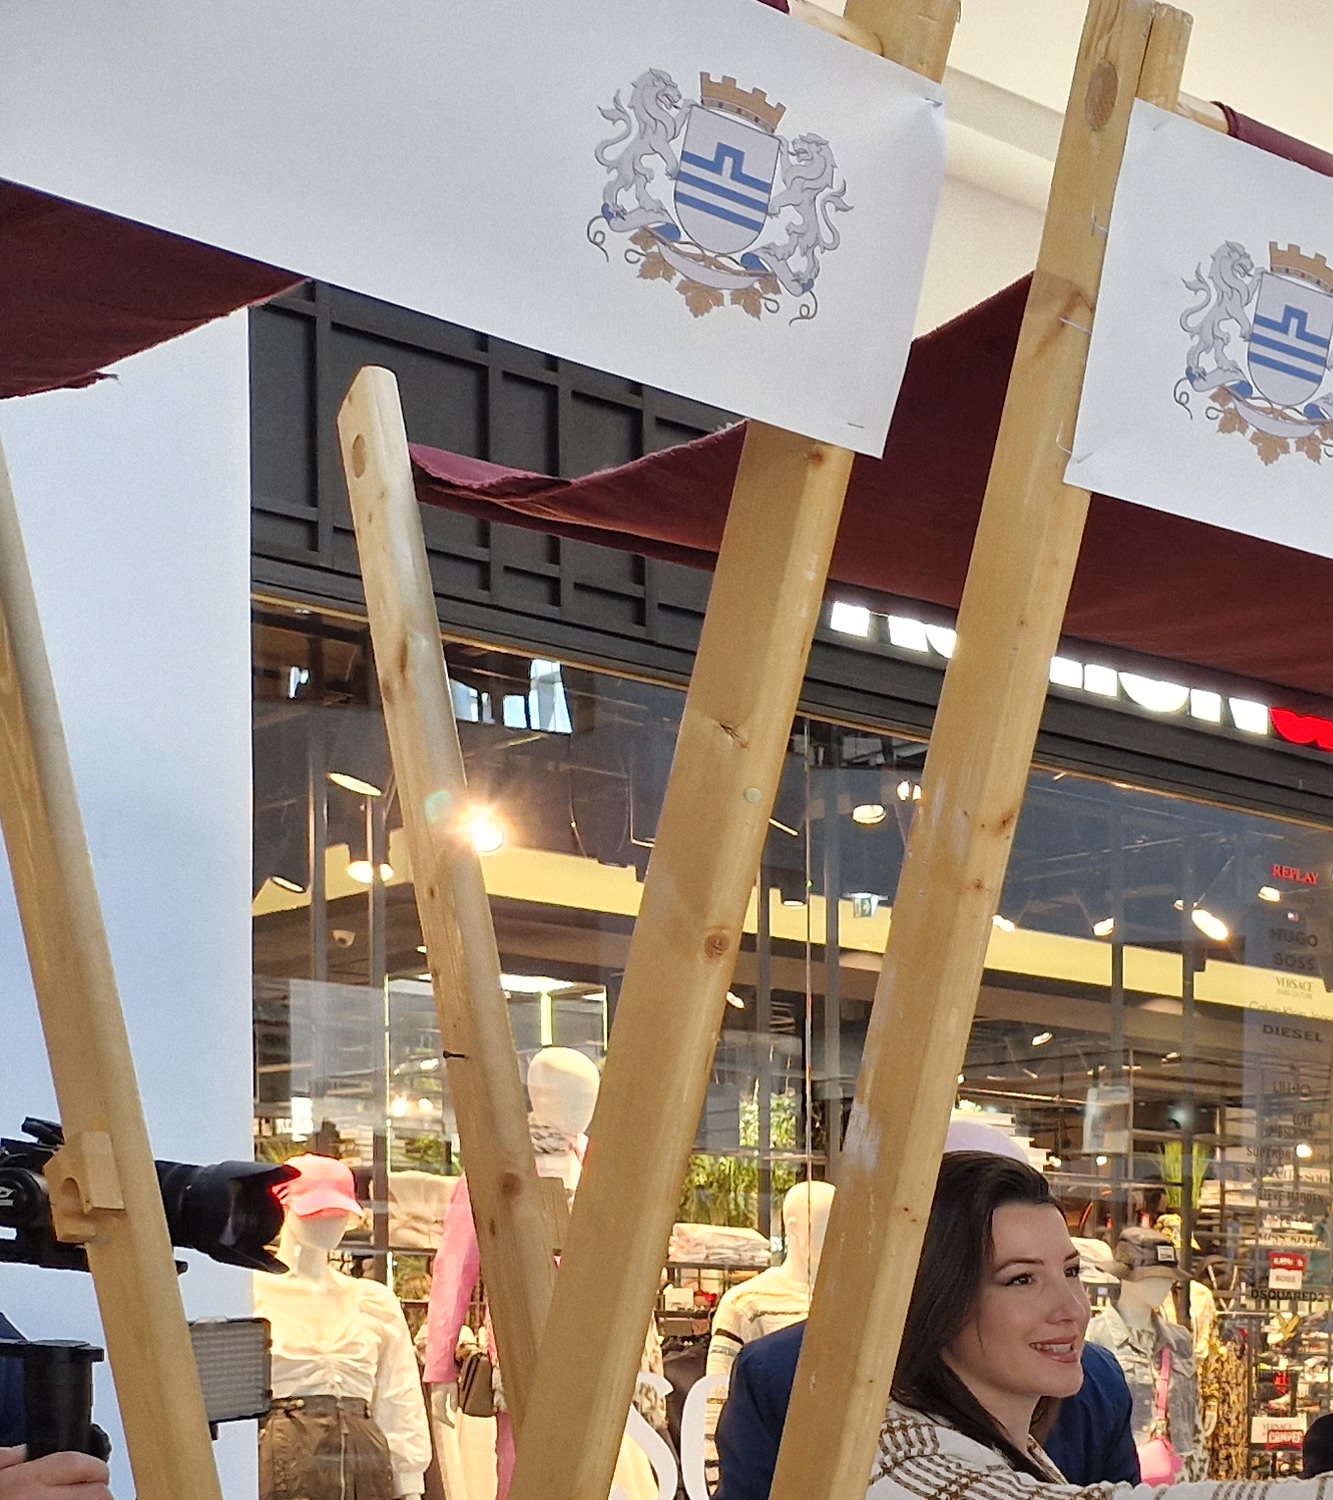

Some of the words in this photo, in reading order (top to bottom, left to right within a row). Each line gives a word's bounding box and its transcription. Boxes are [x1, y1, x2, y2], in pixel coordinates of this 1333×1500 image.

[1271, 863, 1319, 886] REPLAY
[1268, 927, 1319, 948] HUGO
[1273, 952, 1315, 971] BOSS
[1275, 976, 1313, 991] VERSACE
[1262, 1024, 1324, 1043] DIESEL
[1275, 1275, 1297, 1283] BOSS
[1250, 1289, 1325, 1302] DSQUARED2
